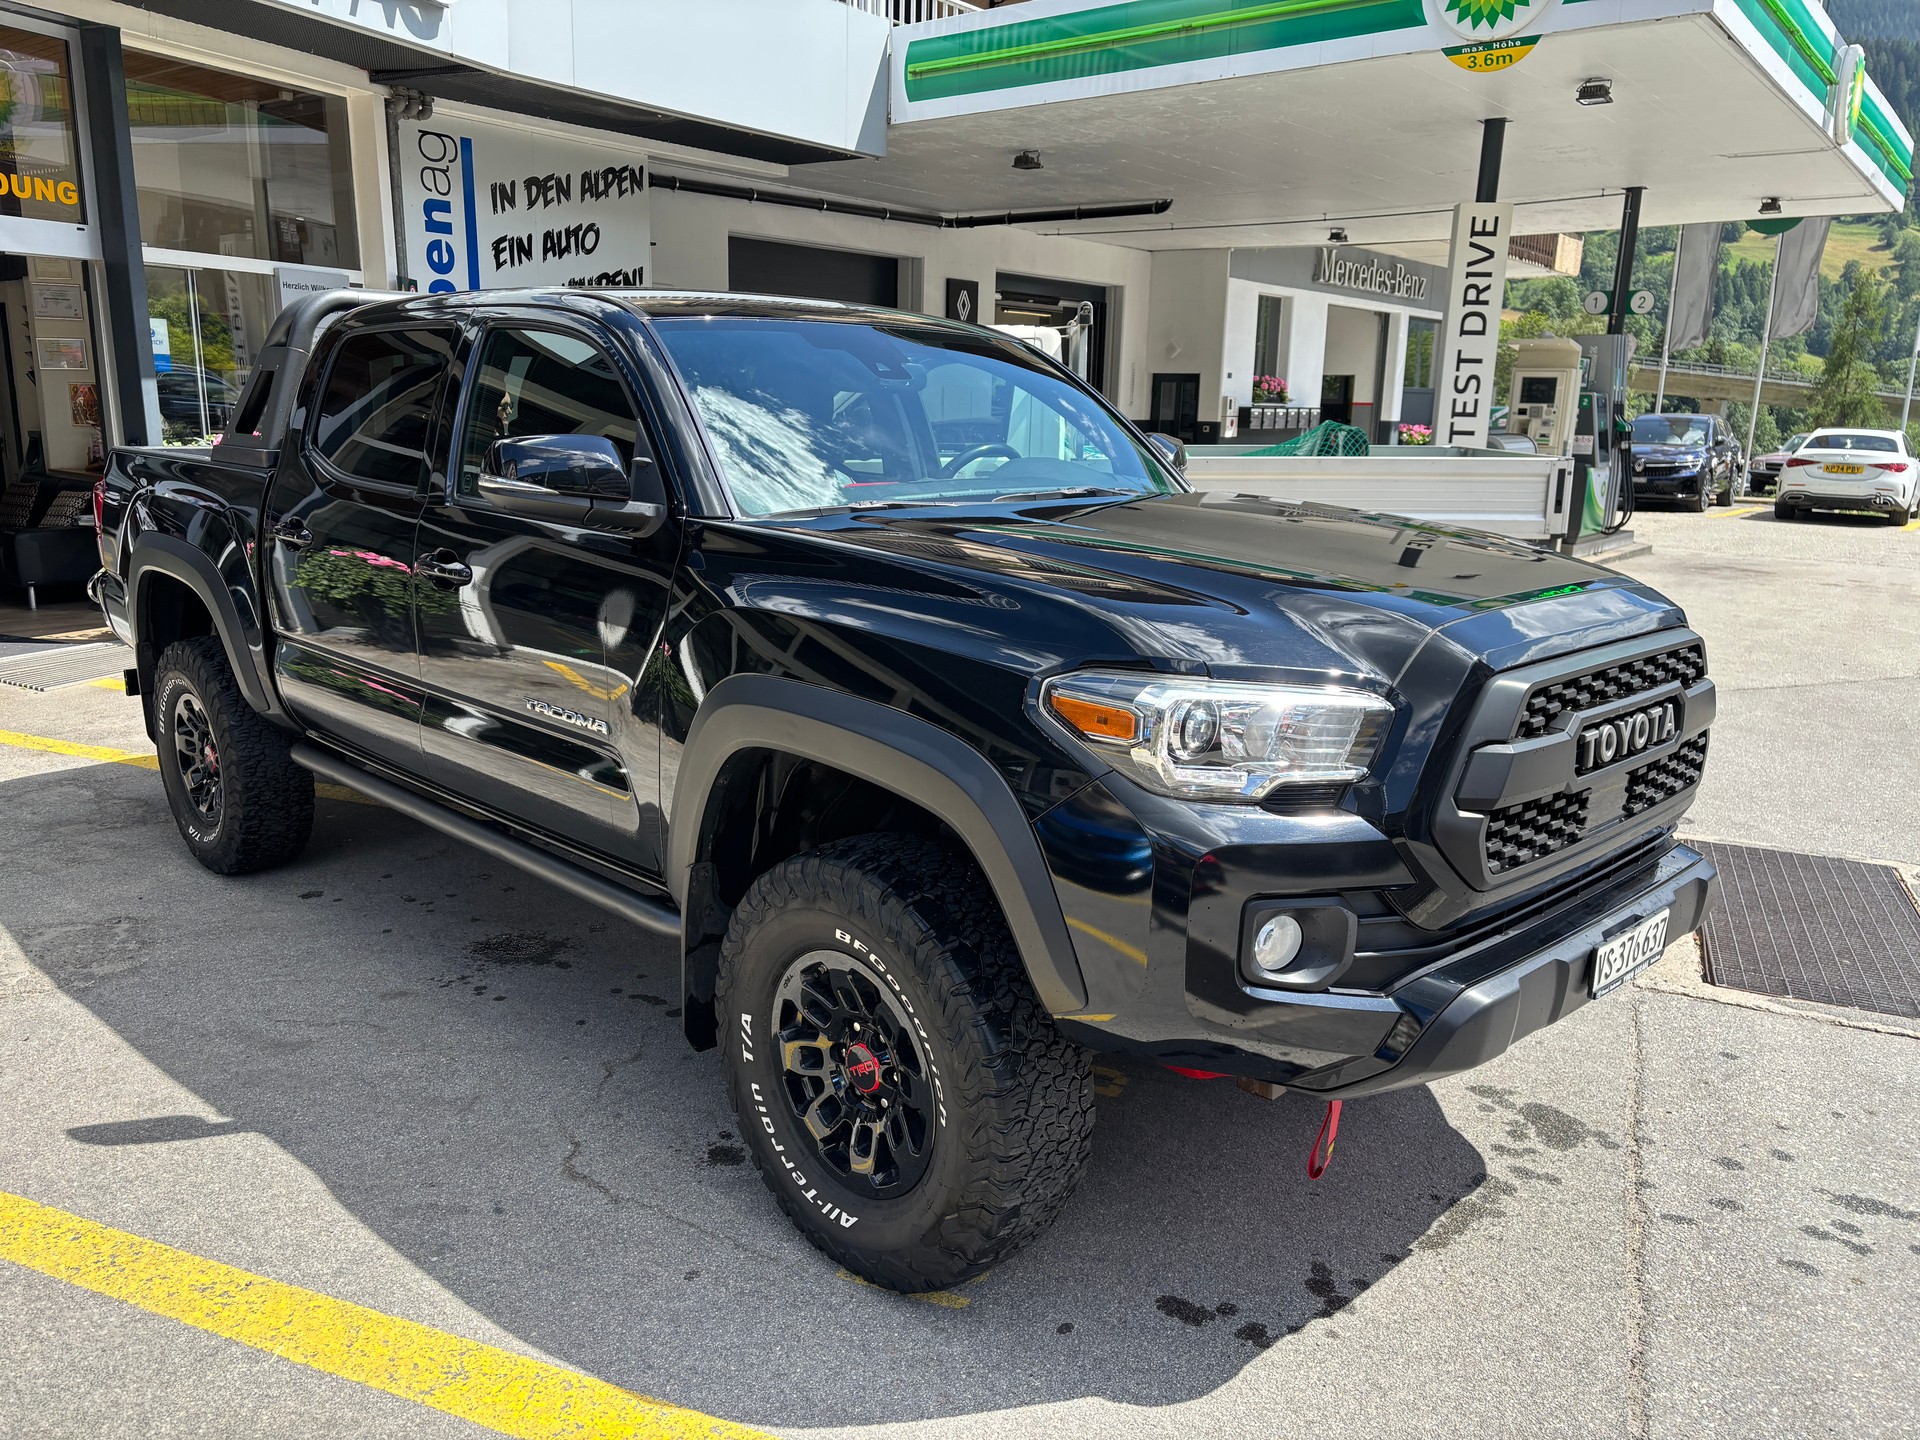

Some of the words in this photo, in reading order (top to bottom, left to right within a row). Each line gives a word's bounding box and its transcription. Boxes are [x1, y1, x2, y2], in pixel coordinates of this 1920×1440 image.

[1462, 46, 1488, 54] max.
[1493, 40, 1521, 49] Höhe
[1467, 53, 1514, 69] 3.6m
[490, 179, 517, 216] IN
[523, 173, 572, 211] DEN
[580, 164, 645, 203] ALPEN
[491, 233, 534, 273] EIN
[541, 222, 601, 264] AUTO
[282, 281, 310, 291] Herzlich
[1318, 247, 1427, 300] Mercedes-Benz
[1459, 216, 1500, 338] DRIVE
[1592, 297, 1600, 309] 1
[1637, 296, 1646, 310] 2
[1449, 349, 1484, 444] TEST
[523, 697, 611, 735] TACOMA
[1579, 703, 1677, 770] TOYOTA
[188, 825, 201, 841] T/A
[742, 1013, 753, 1063] T/A
[836, 928, 948, 1128] BFGoodrich
[850, 1060, 874, 1077] TRD
[751, 1083, 859, 1228] All-Terrain
